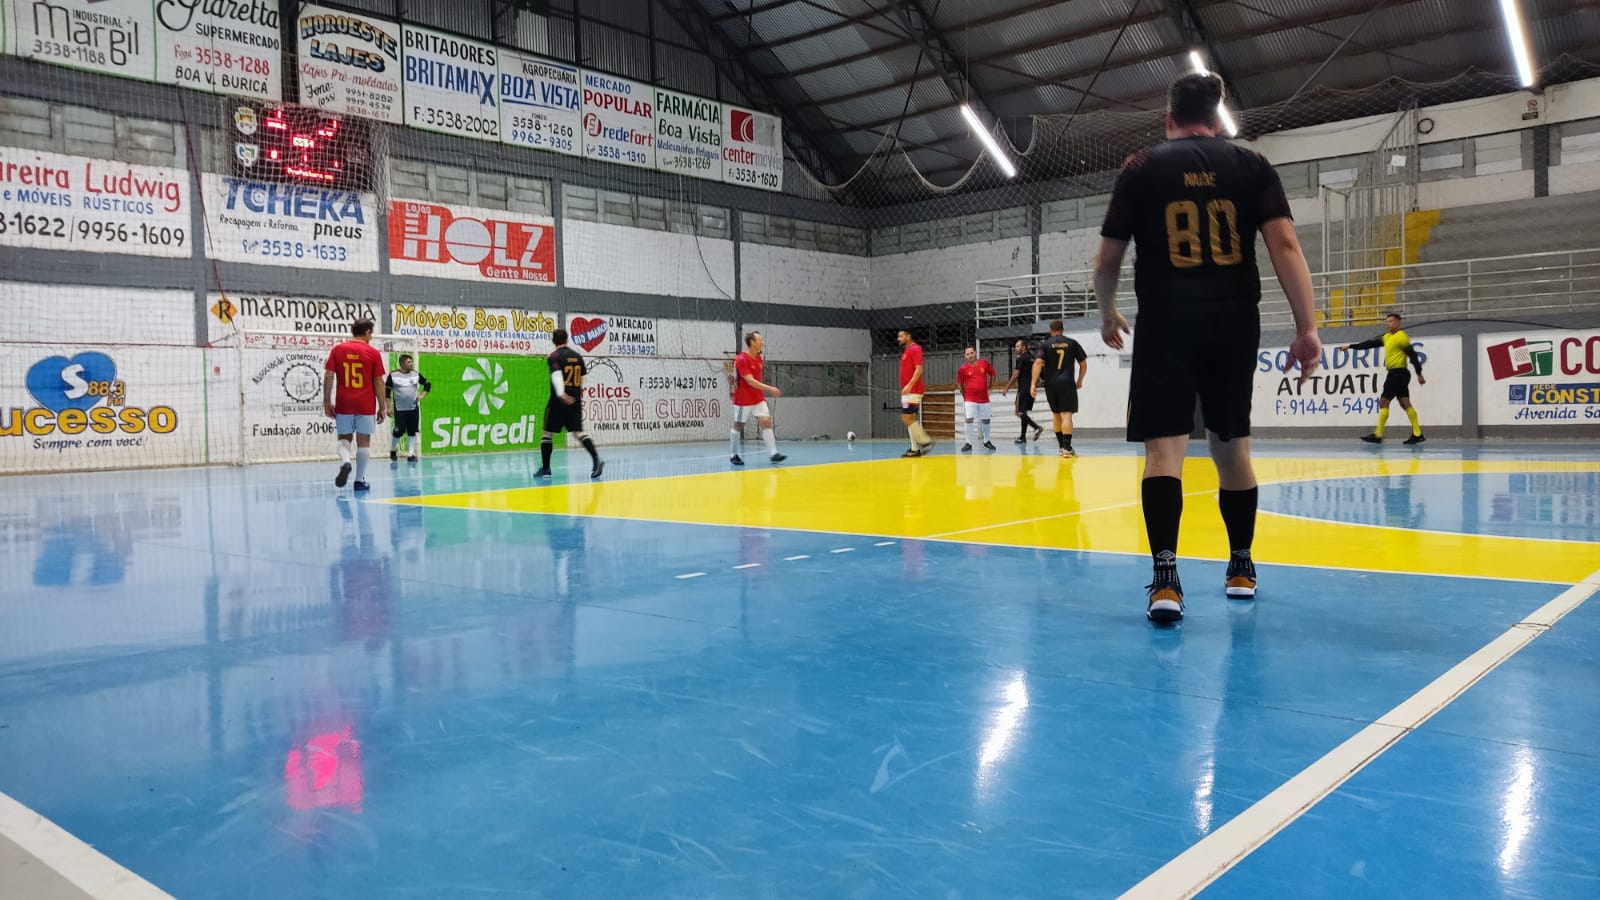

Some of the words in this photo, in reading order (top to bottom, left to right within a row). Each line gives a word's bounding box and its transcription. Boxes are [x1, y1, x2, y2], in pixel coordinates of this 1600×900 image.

[72, 9, 123, 28] INDUSTRIAL
[196, 23, 279, 50] SUPERMERCADO
[300, 14, 398, 62] NOROESTE
[33, 40, 105, 64] 3538-1188
[310, 39, 385, 73] LAJES
[405, 30, 496, 66] BRITADORES
[196, 47, 270, 76] 3538-1288
[176, 66, 200, 84] BOA
[406, 56, 496, 107] BRITAMAX
[585, 75, 632, 94] MERCADO
[501, 73, 536, 101] BOA
[541, 81, 580, 111] VISTA
[583, 88, 653, 119] POPULAR
[656, 92, 720, 124] FARMÁCIA
[513, 116, 572, 138] 3538-1260
[658, 119, 682, 139] Boa
[689, 124, 720, 146] Vista
[512, 130, 572, 152] 9962-9305
[598, 144, 646, 164] 3538-1310
[0, 156, 70, 190] reira
[86, 162, 180, 212] Ludwig
[18, 188, 72, 207] MÓVEIS
[83, 194, 154, 215] RÚSTICOS
[222, 177, 364, 225] TCHEKA
[314, 222, 362, 240] pneus
[403, 214, 544, 270] HOLZ
[1165, 199, 1242, 268] 80
[262, 240, 346, 262] 3538-1633
[486, 266, 518, 280] Gente
[394, 304, 467, 332] Móveis
[474, 307, 508, 331] Boa
[511, 309, 556, 333] Vista
[609, 318, 614, 327] O
[616, 318, 652, 330] MERCADO
[400, 328, 444, 336] QUALIDADE
[574, 334, 586, 346] RIO
[609, 332, 620, 342] DA
[422, 338, 478, 349] 3538-1060
[1056, 349, 1064, 370] 7
[342, 362, 364, 388] 15
[564, 366, 581, 388] 20
[106, 397, 124, 407] FM
[656, 398, 720, 420] CLARA
[1514, 406, 1576, 420] Avenida
[252, 424, 301, 438] Fundação
[431, 414, 536, 449] Sicredi
[32, 438, 82, 454] Sempre
[86, 440, 112, 448] com
